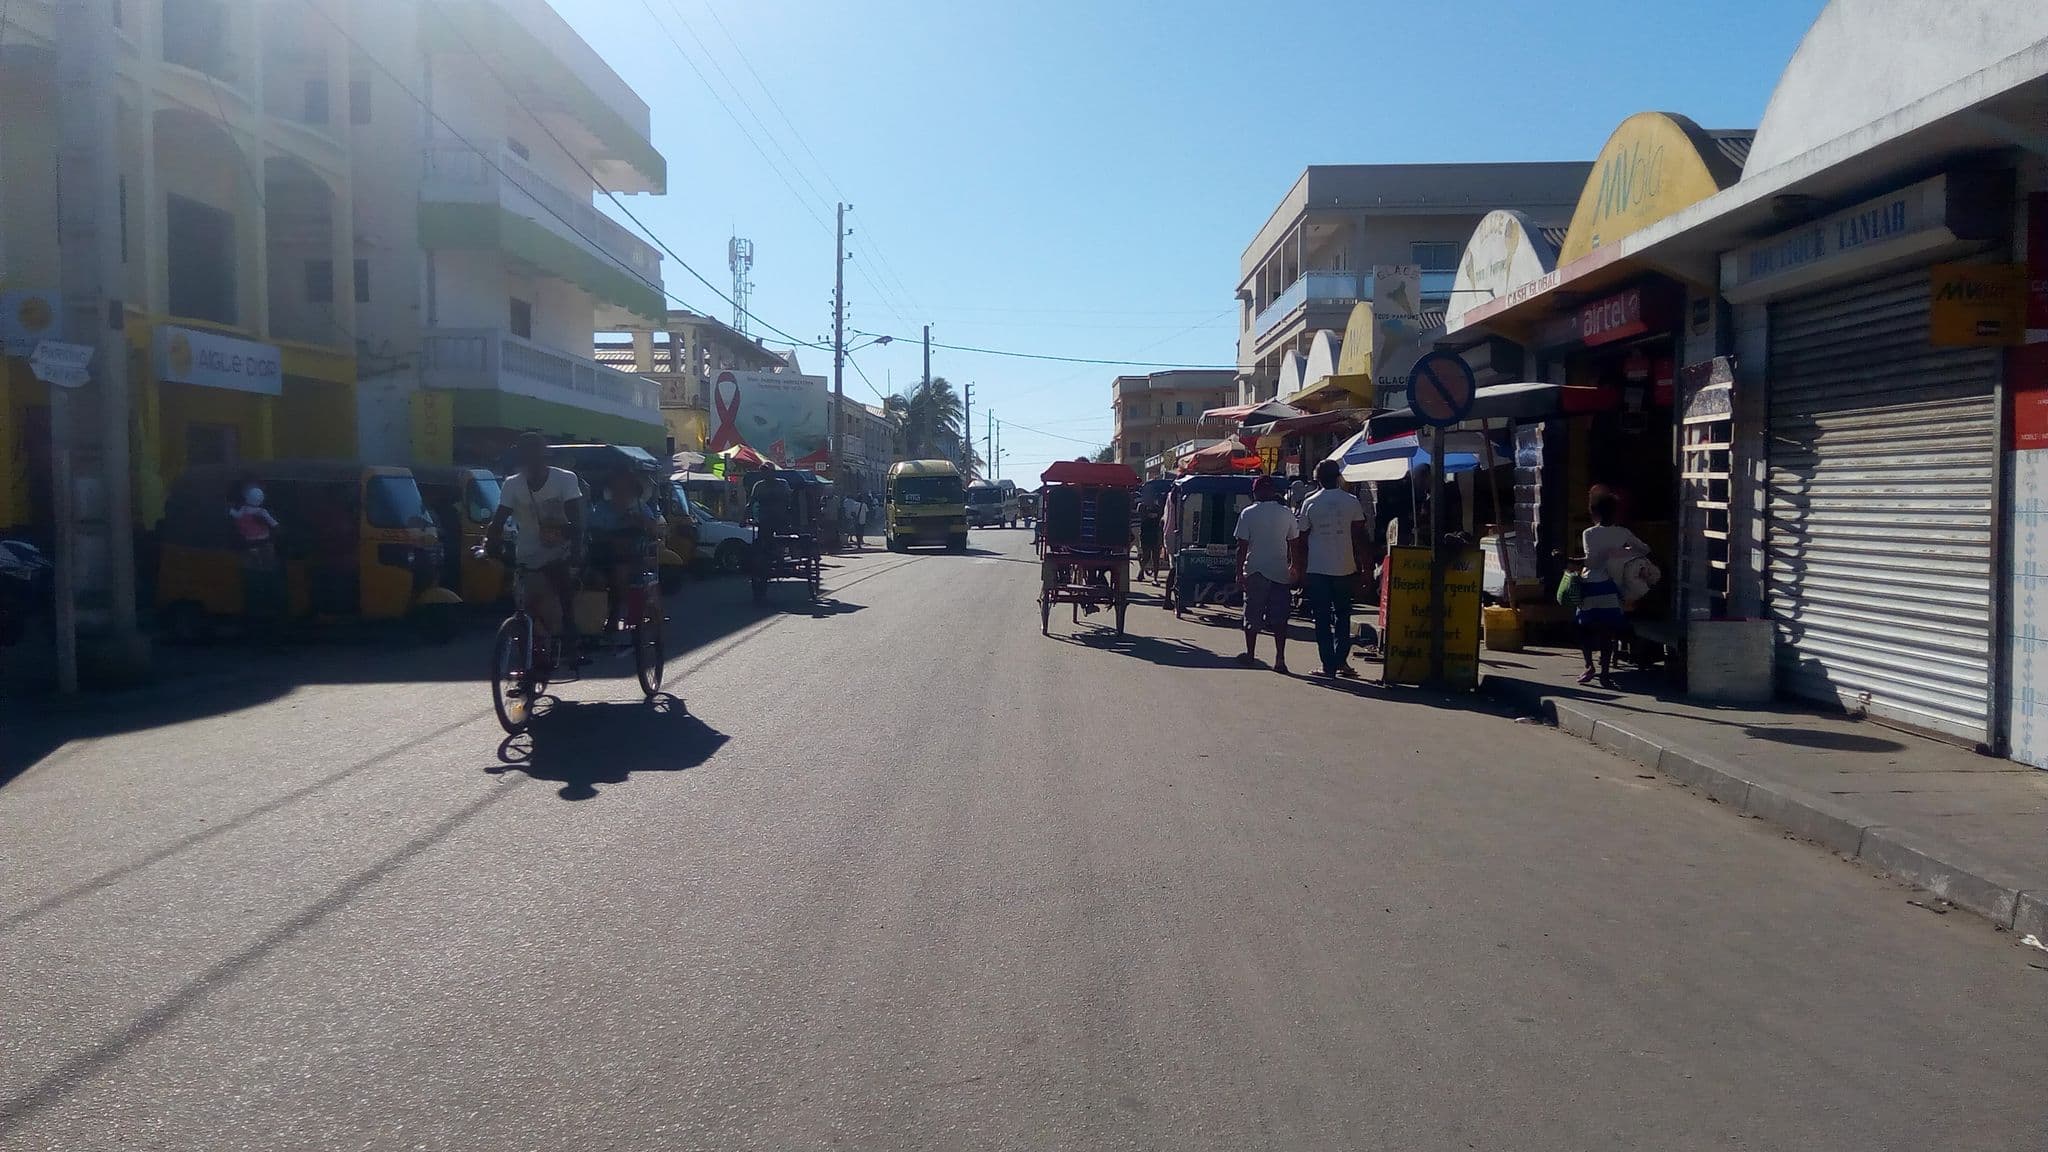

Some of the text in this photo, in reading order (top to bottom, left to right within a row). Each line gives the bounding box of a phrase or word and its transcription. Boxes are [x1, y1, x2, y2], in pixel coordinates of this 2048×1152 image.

[1506, 272, 1558, 307] CASH GLOBAL
[1583, 292, 1627, 338] airtel
